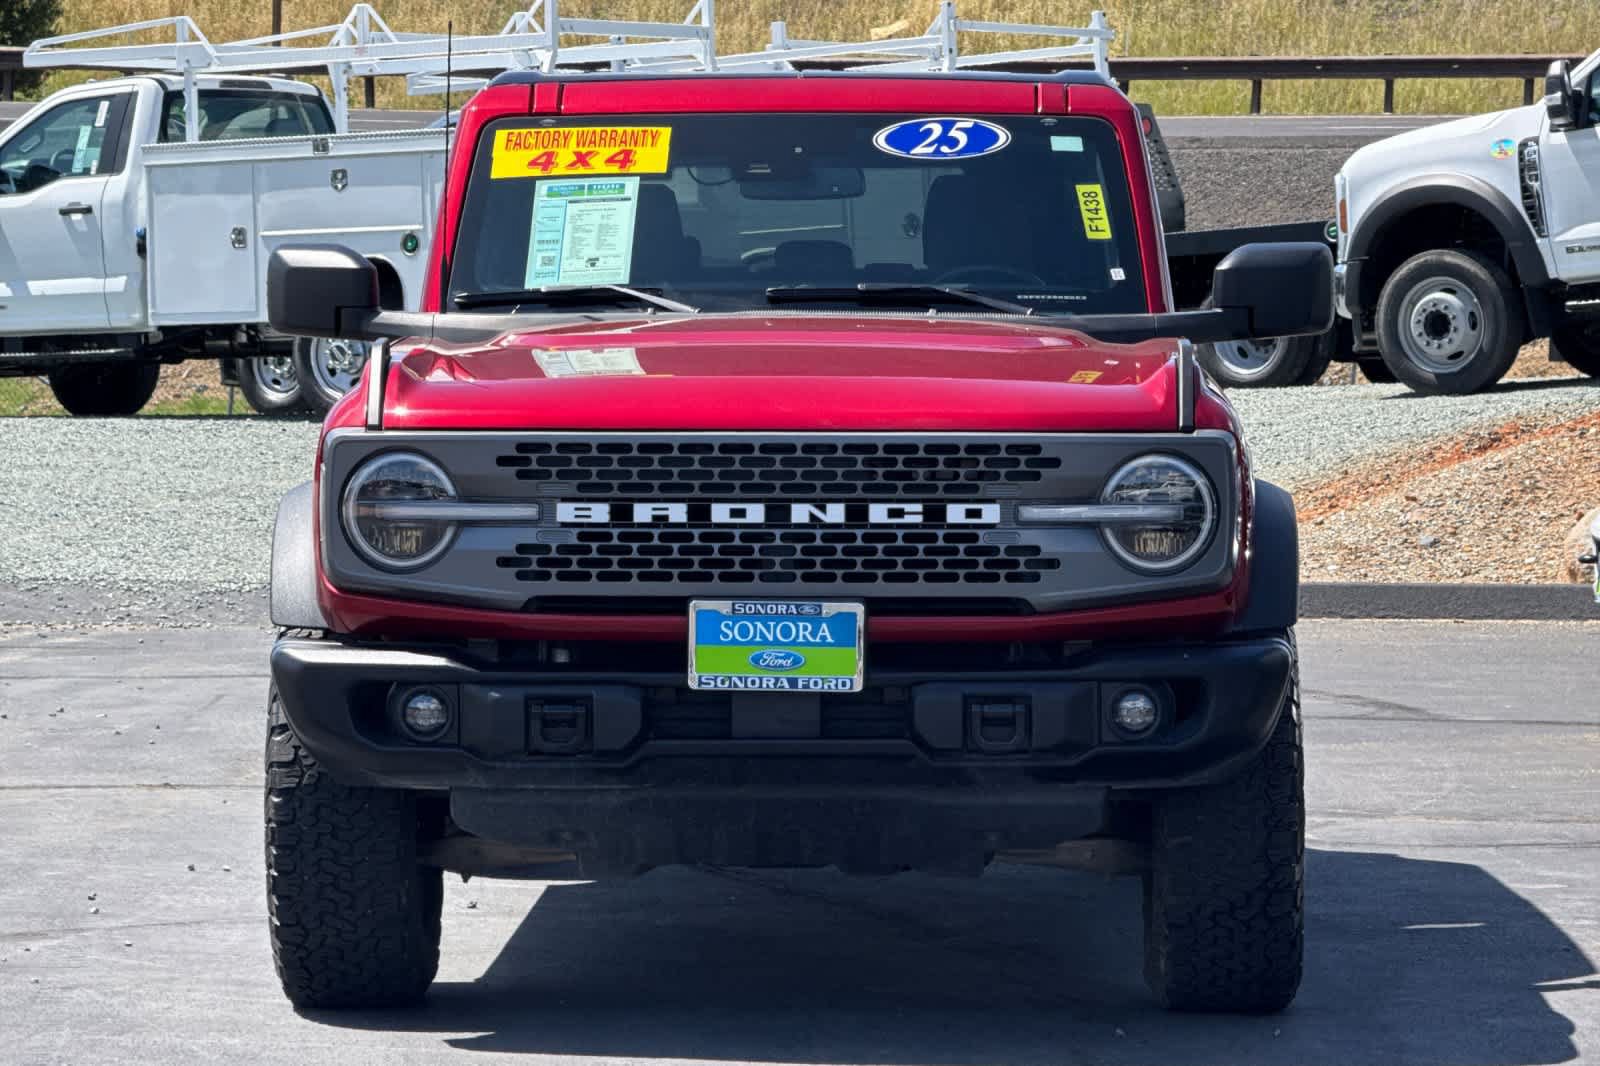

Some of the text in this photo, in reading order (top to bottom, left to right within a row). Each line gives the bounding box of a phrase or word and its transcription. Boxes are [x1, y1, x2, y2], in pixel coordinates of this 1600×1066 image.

[505, 129, 661, 150] FACTORY WARRANTY
[909, 121, 974, 154] 25
[1081, 191, 1106, 232] F1438
[556, 502, 1001, 523] BRONCO
[734, 603, 797, 615] SONORA
[719, 620, 835, 643] SONORA
[759, 650, 794, 667] Ford
[700, 676, 851, 690] SONORA FORD
